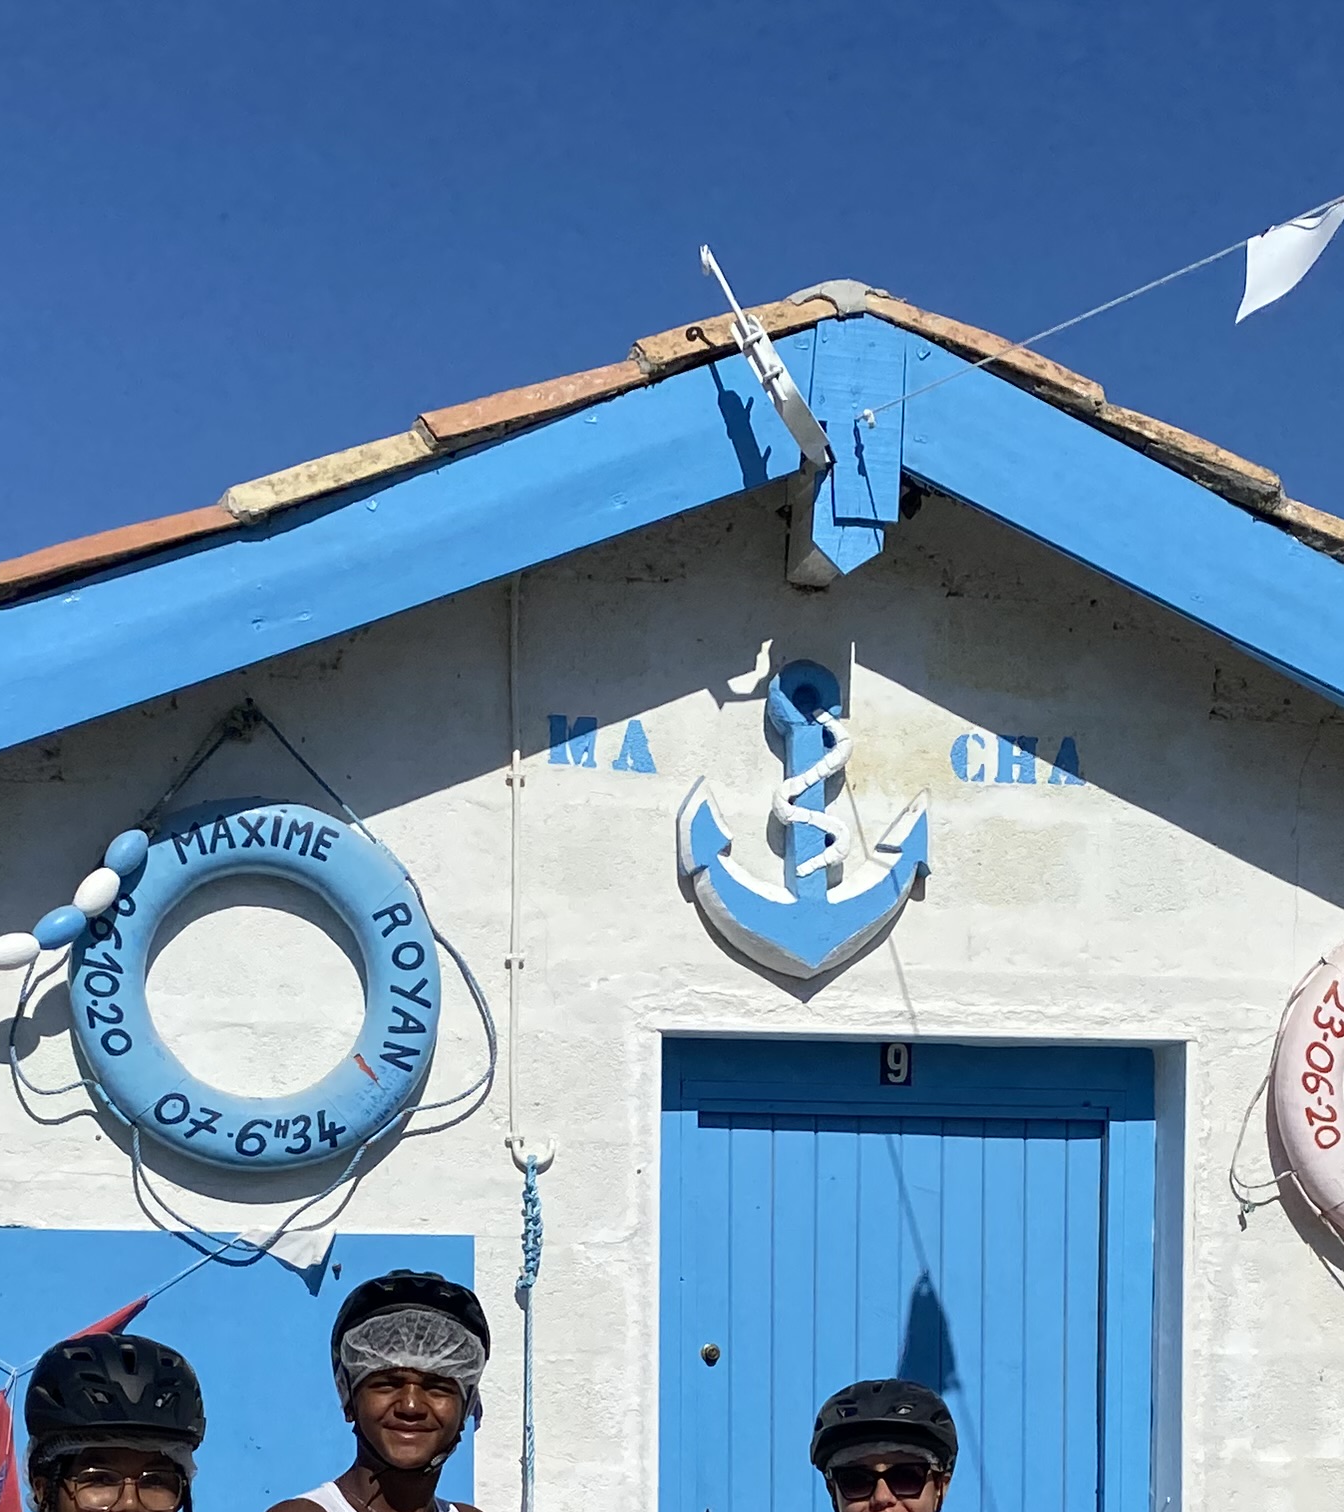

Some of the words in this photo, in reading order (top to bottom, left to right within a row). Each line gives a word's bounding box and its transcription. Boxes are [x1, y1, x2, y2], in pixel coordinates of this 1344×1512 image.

[547, 714, 656, 775] MA
[950, 733, 1086, 785] CHA
[171, 813, 340, 864] MAXIME
[372, 902, 433, 1073] ROYAN
[885, 1042, 909, 1084] 9
